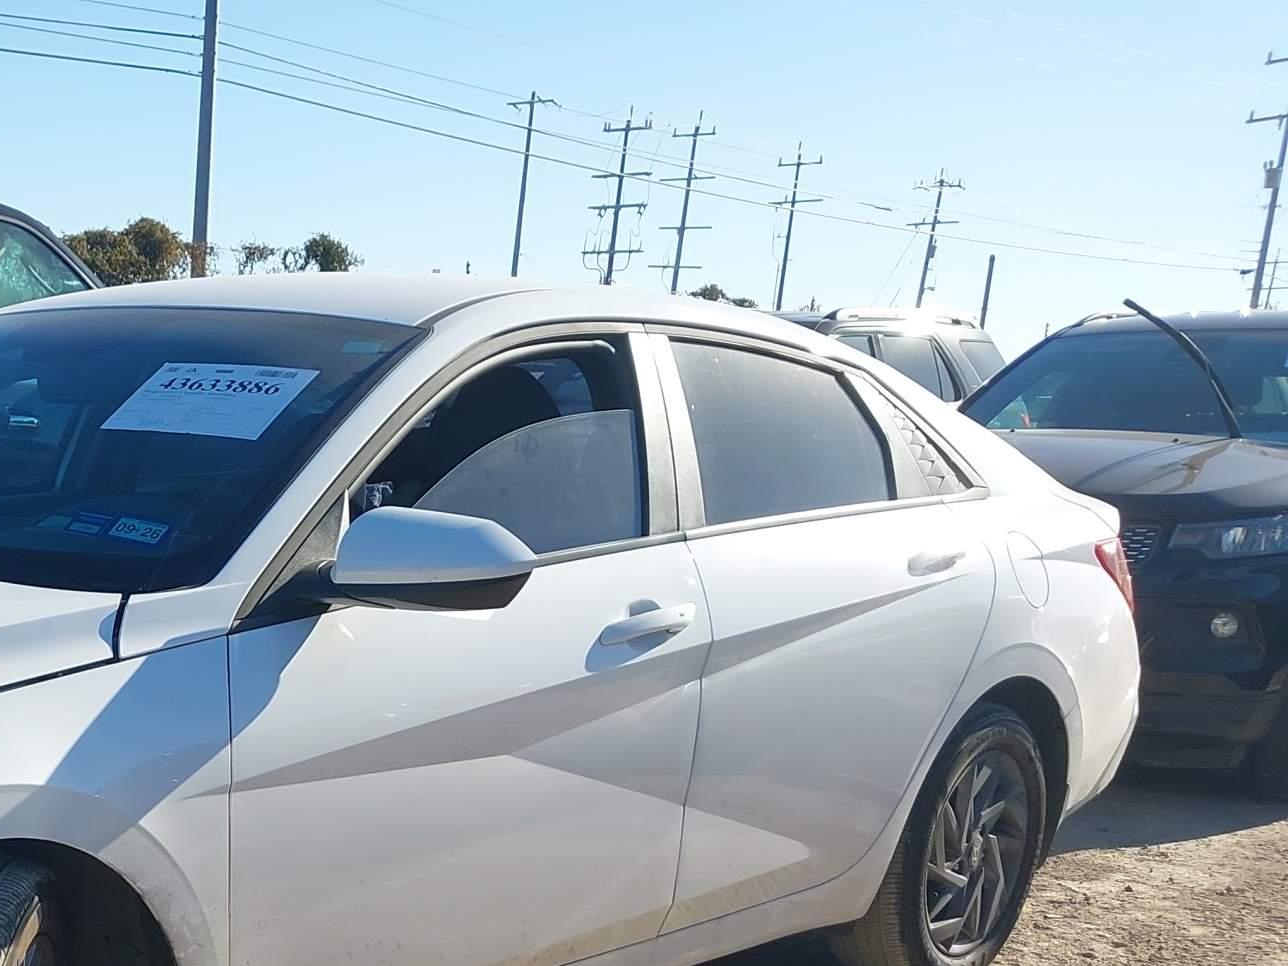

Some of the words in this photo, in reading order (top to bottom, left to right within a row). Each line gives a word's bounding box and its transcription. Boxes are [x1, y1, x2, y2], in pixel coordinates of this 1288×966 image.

[159, 377, 285, 396] 43633886
[115, 523, 137, 534] 09
[140, 527, 163, 539] 26
